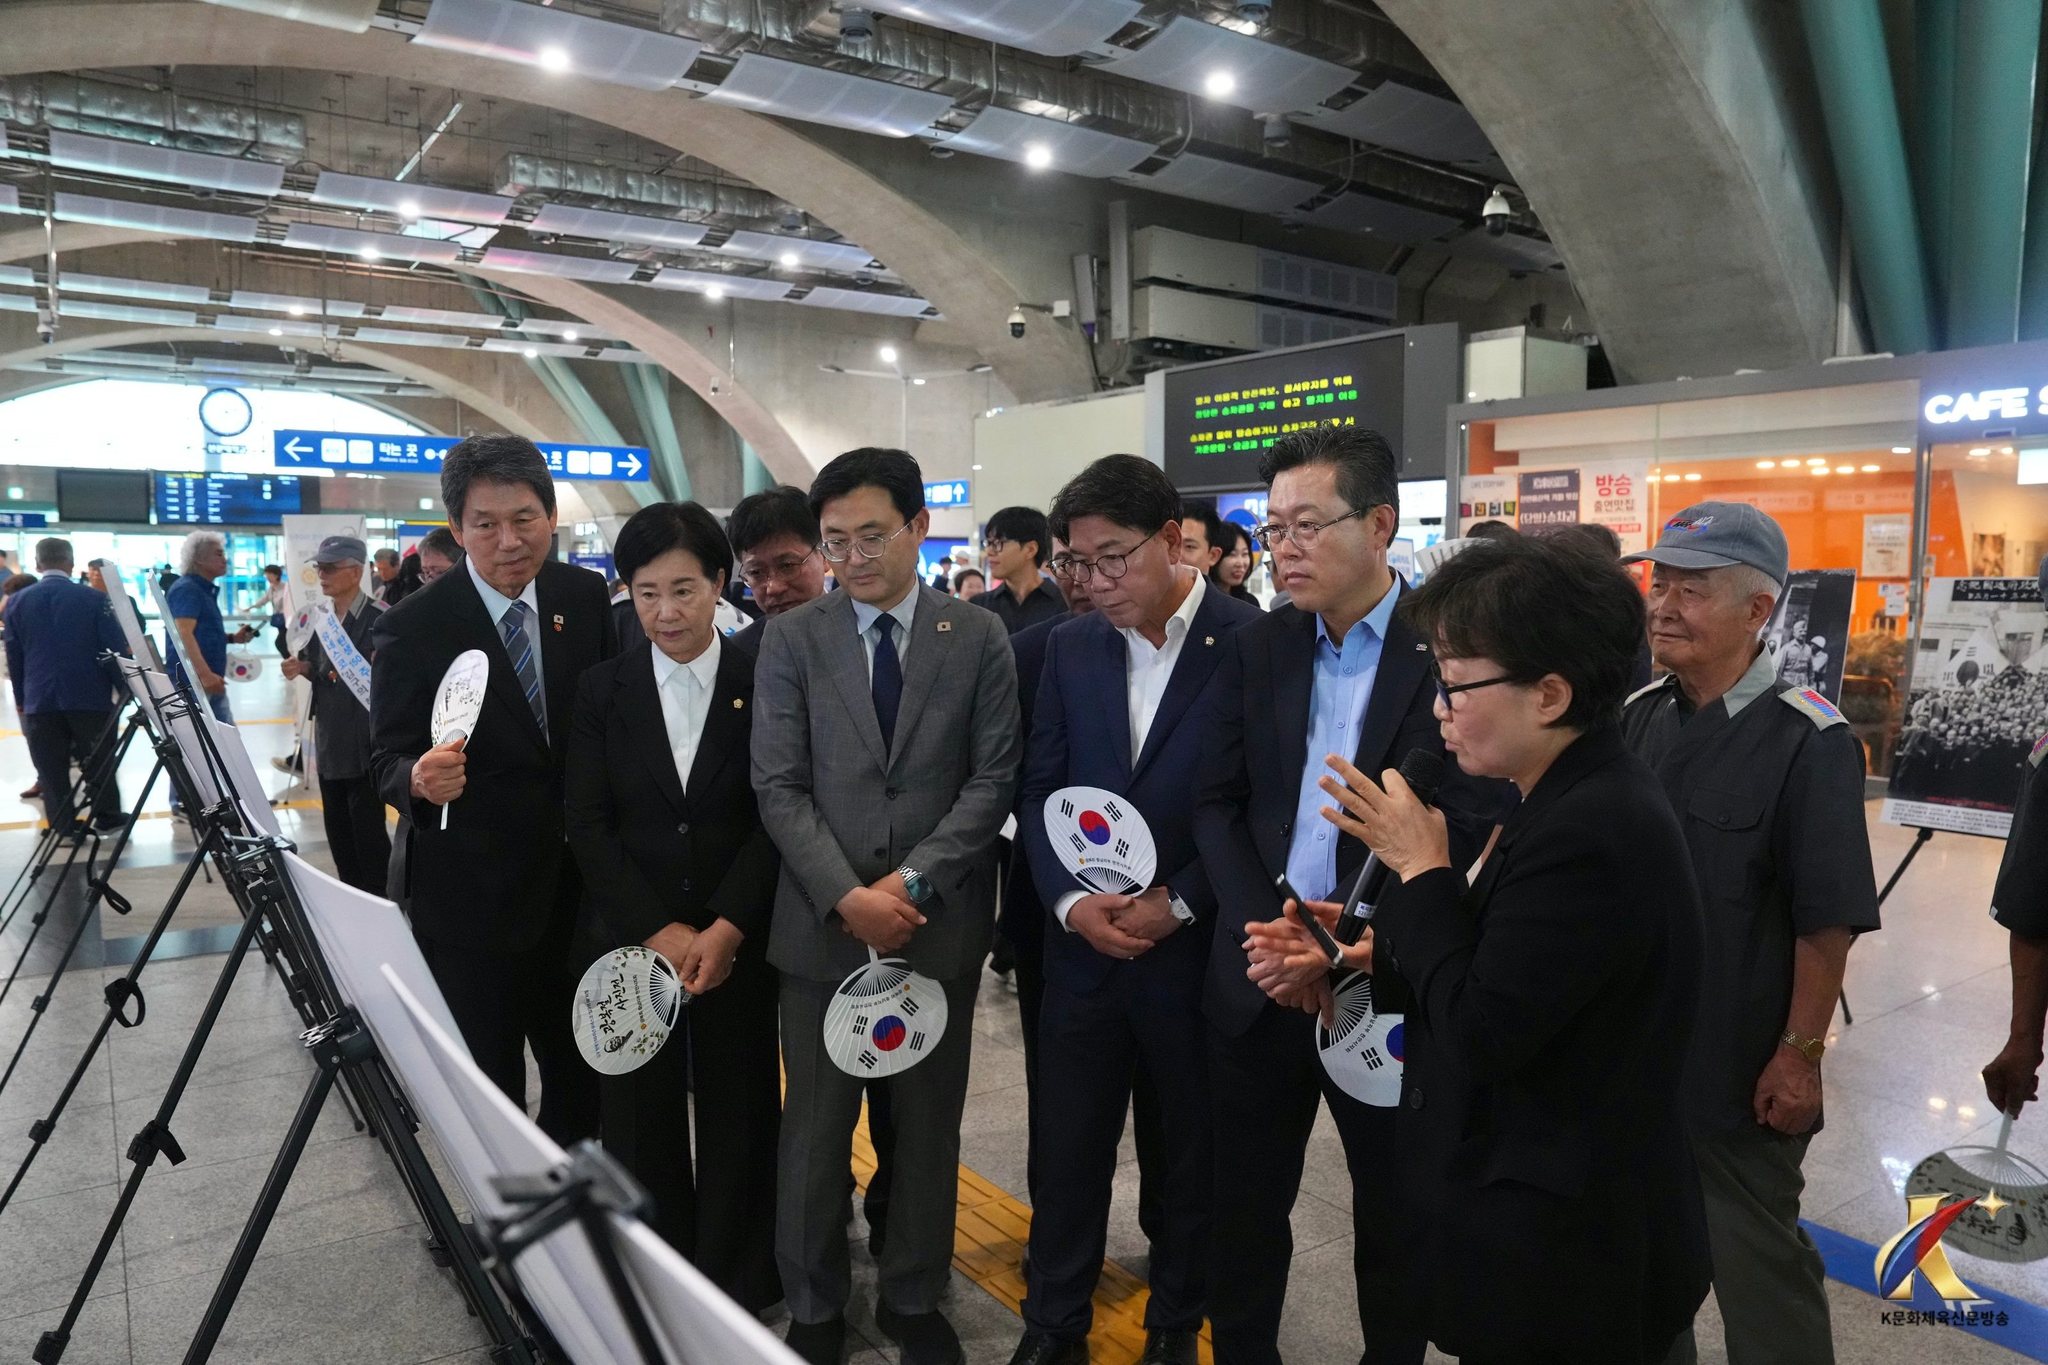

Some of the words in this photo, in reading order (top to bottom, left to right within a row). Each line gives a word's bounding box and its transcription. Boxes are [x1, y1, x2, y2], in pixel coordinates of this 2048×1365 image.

[1925, 387, 2029, 424] CAFE
[379, 442, 402, 457] 타는
[406, 443, 418, 458] 곳
[1595, 474, 1632, 497] 방송
[1594, 499, 1635, 514] 출연맛집
[610, 972, 630, 1011] 사진전
[596, 994, 616, 1035] 광복절
